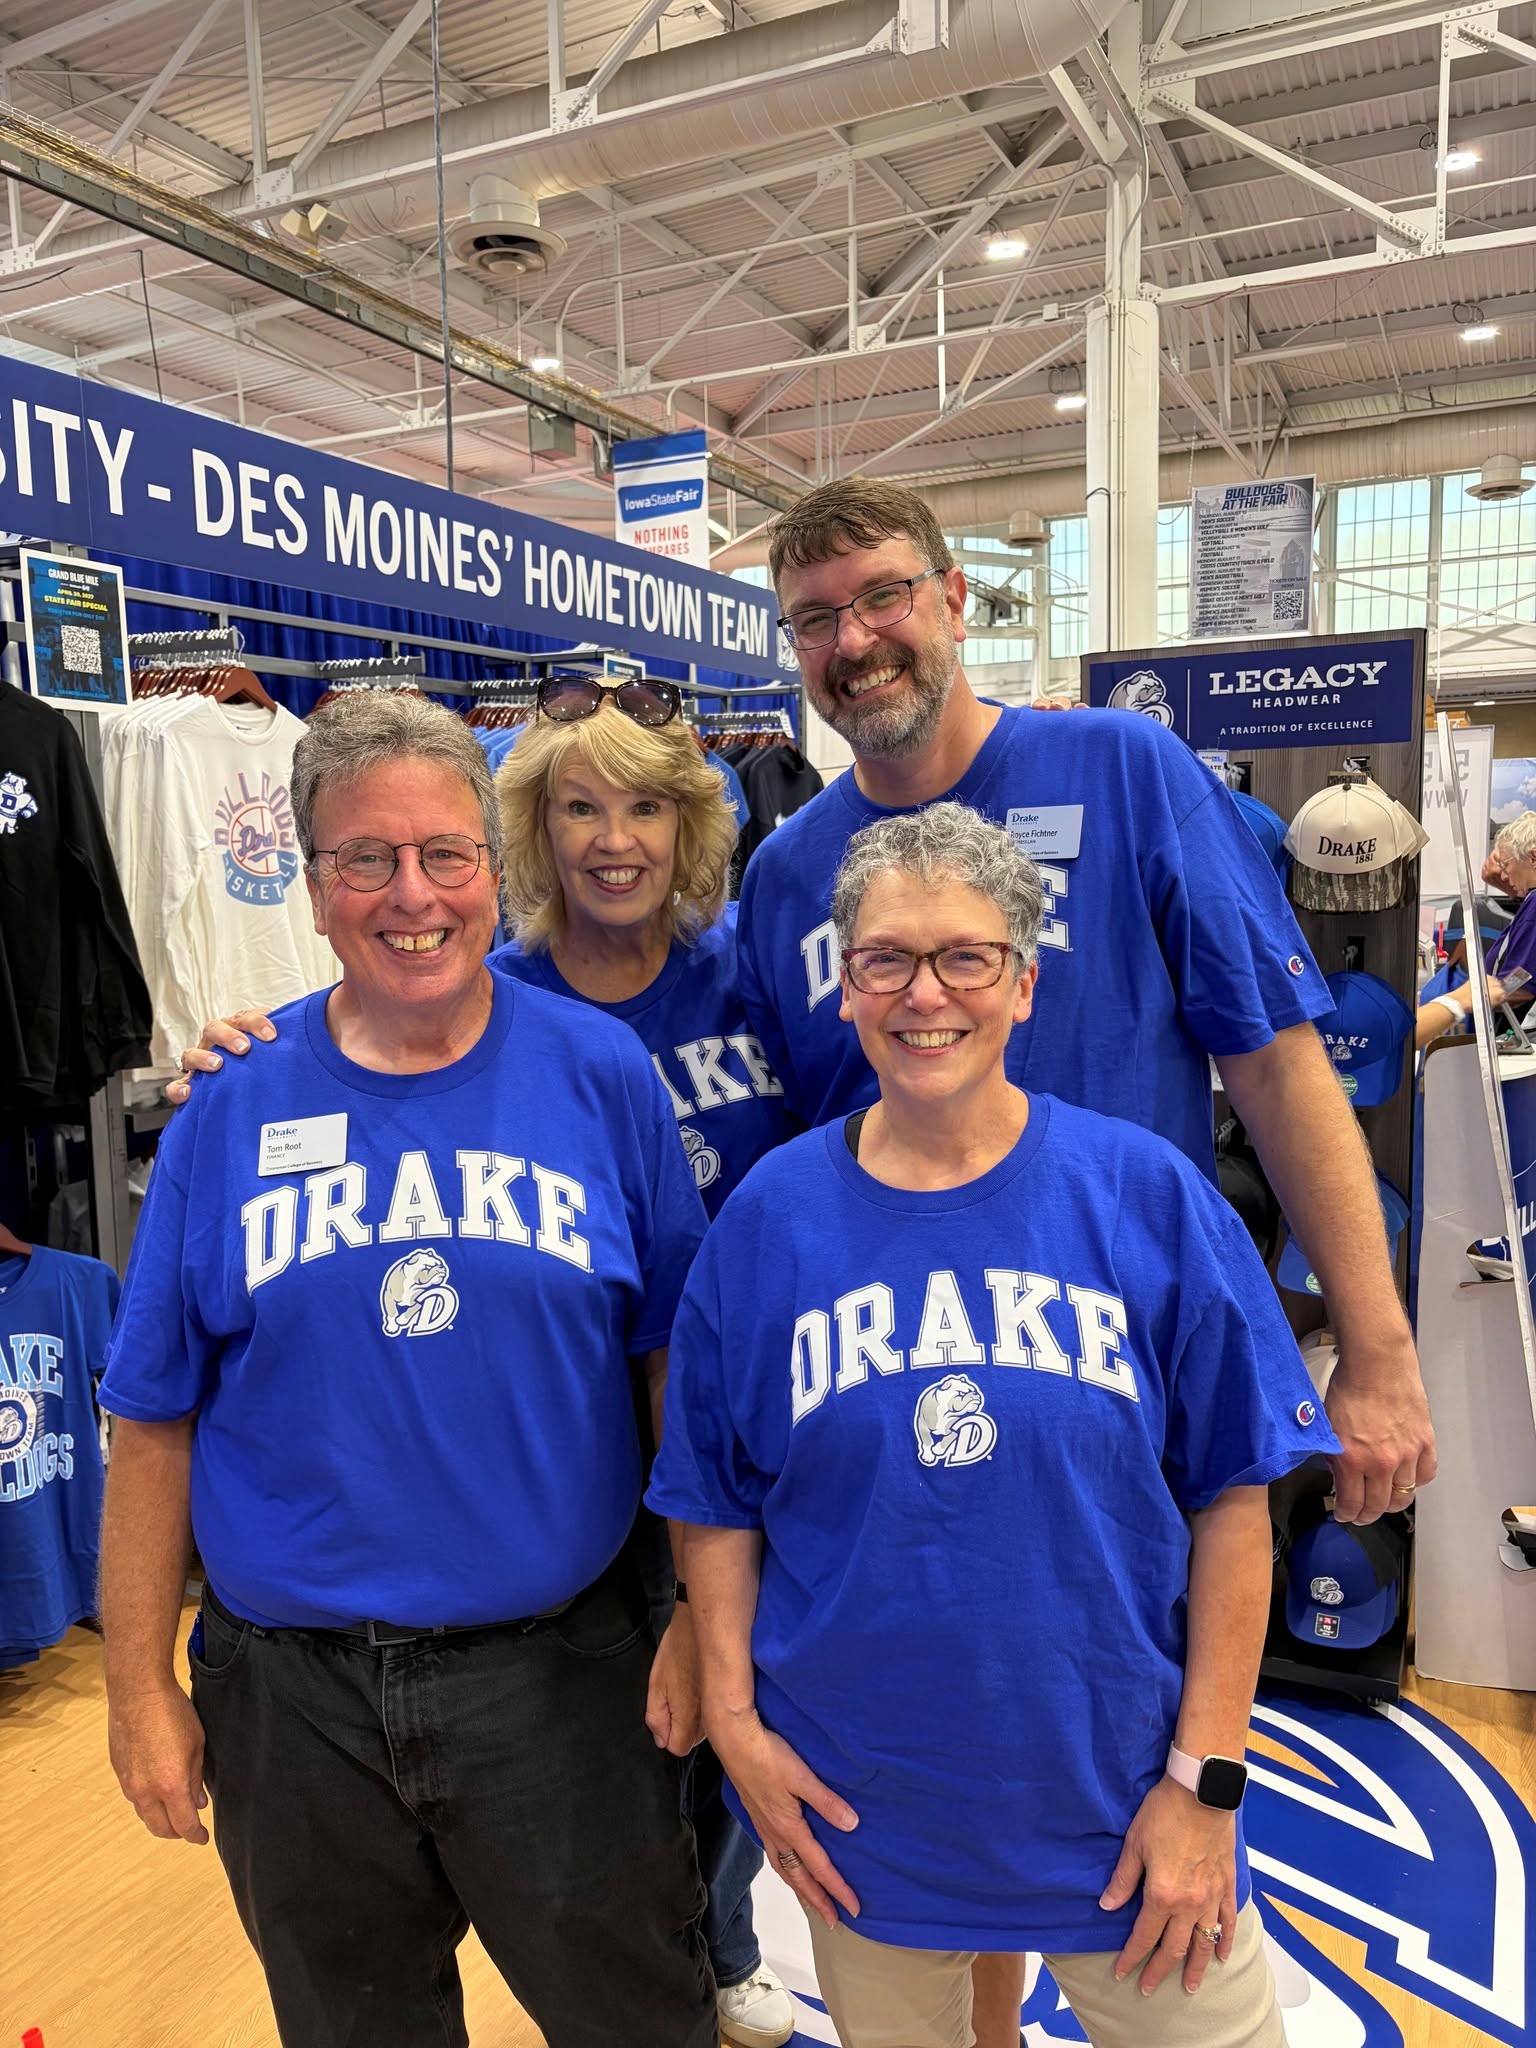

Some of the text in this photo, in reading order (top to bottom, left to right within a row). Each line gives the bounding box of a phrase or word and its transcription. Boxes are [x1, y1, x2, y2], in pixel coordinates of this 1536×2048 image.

[1225, 483, 1285, 499] BULLDOGS
[625, 488, 699, 511] IowaStateFair
[1222, 494, 1288, 510] AT THE FAIR
[0, 399, 134, 516] ITY
[192, 448, 308, 555] DES
[524, 540, 701, 642] HOMETOWN
[707, 592, 768, 658] TEAM
[634, 525, 689, 545] NOTHING
[48, 568, 99, 586] GRAND BLUE MILE
[66, 599, 81, 607] FAIR
[82, 601, 108, 611] SPECIAL
[1209, 661, 1387, 695] LEGACY
[1252, 694, 1341, 709] HEADWEAR
[1219, 719, 1374, 735] A TRADITION OF EXCELLENCE
[1011, 813, 1039, 823] Drake
[1031, 829, 1058, 838] Fichtner
[1317, 835, 1377, 857] DRAKE
[1355, 853, 1374, 864] 1881
[267, 1127, 298, 1137] Drake
[267, 1142, 302, 1153] Tom Root
[241, 1149, 592, 1296] DRAKE
[790, 1268, 1140, 1428] DRAKE
